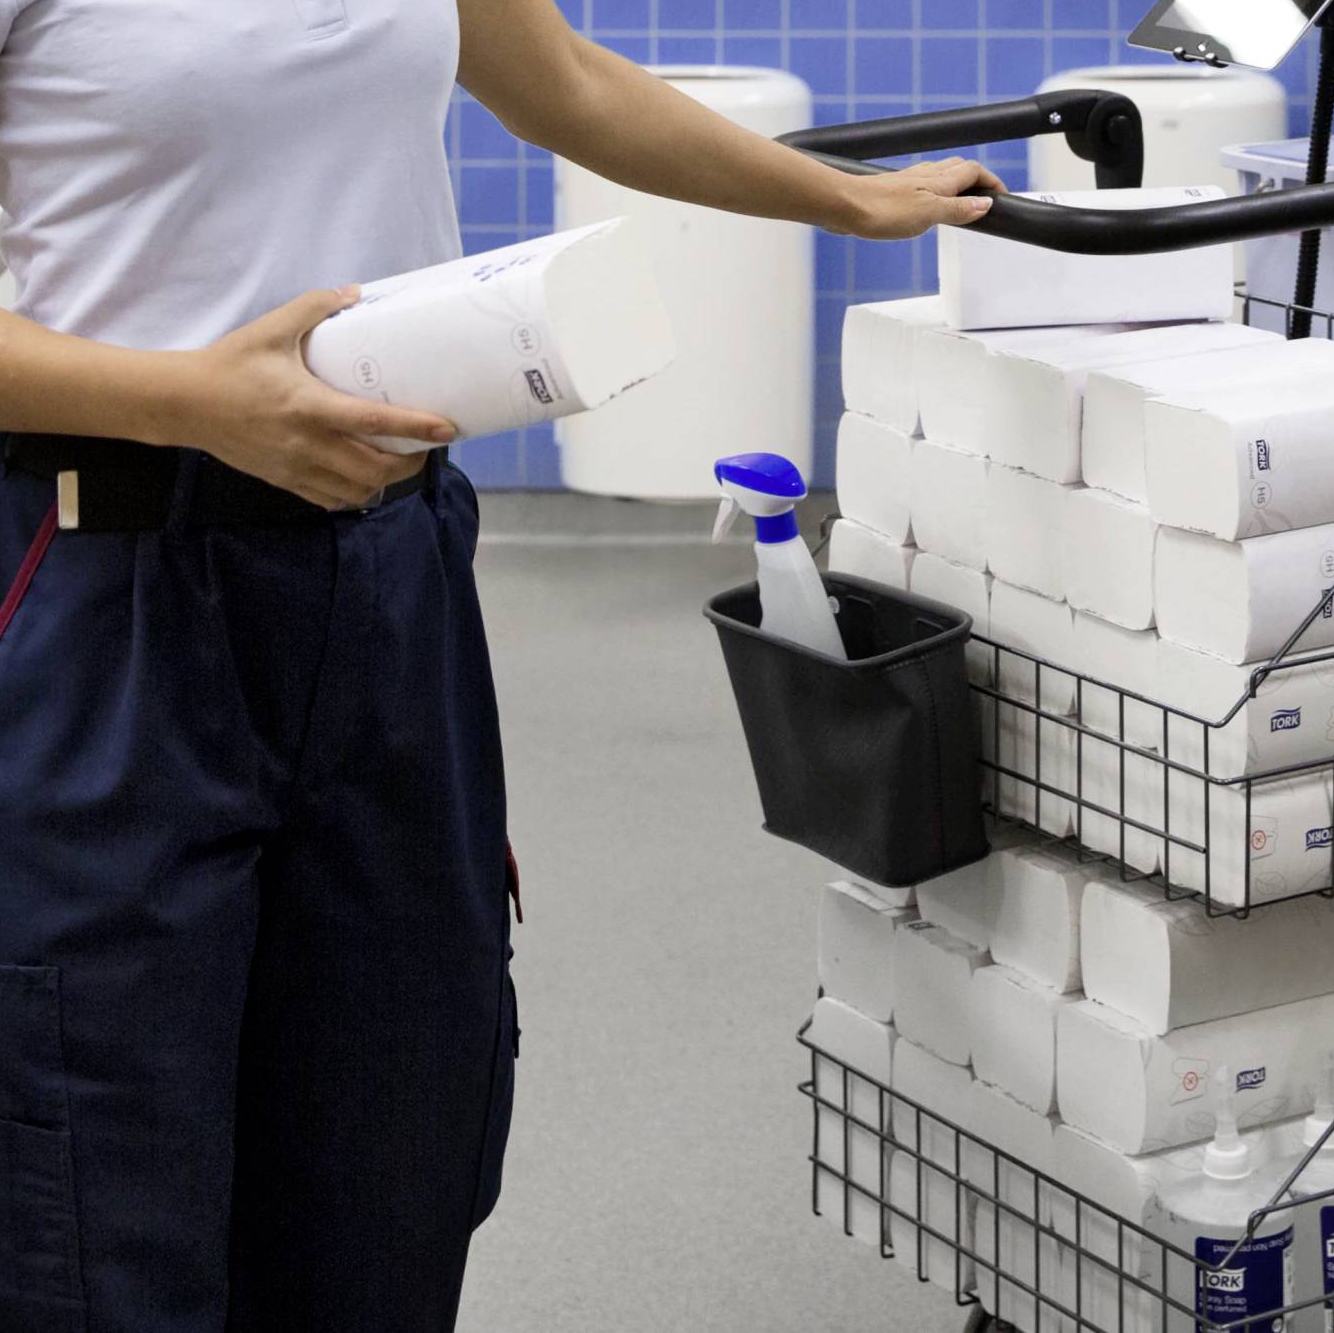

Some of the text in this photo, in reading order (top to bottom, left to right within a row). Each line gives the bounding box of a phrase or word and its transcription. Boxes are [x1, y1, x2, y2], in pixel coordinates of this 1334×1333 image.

[1256, 440, 1267, 470] TORK
[1271, 713, 1300, 731] TORK
[1237, 1070, 1264, 1086] TORK
[1204, 1274, 1242, 1288] ORK
